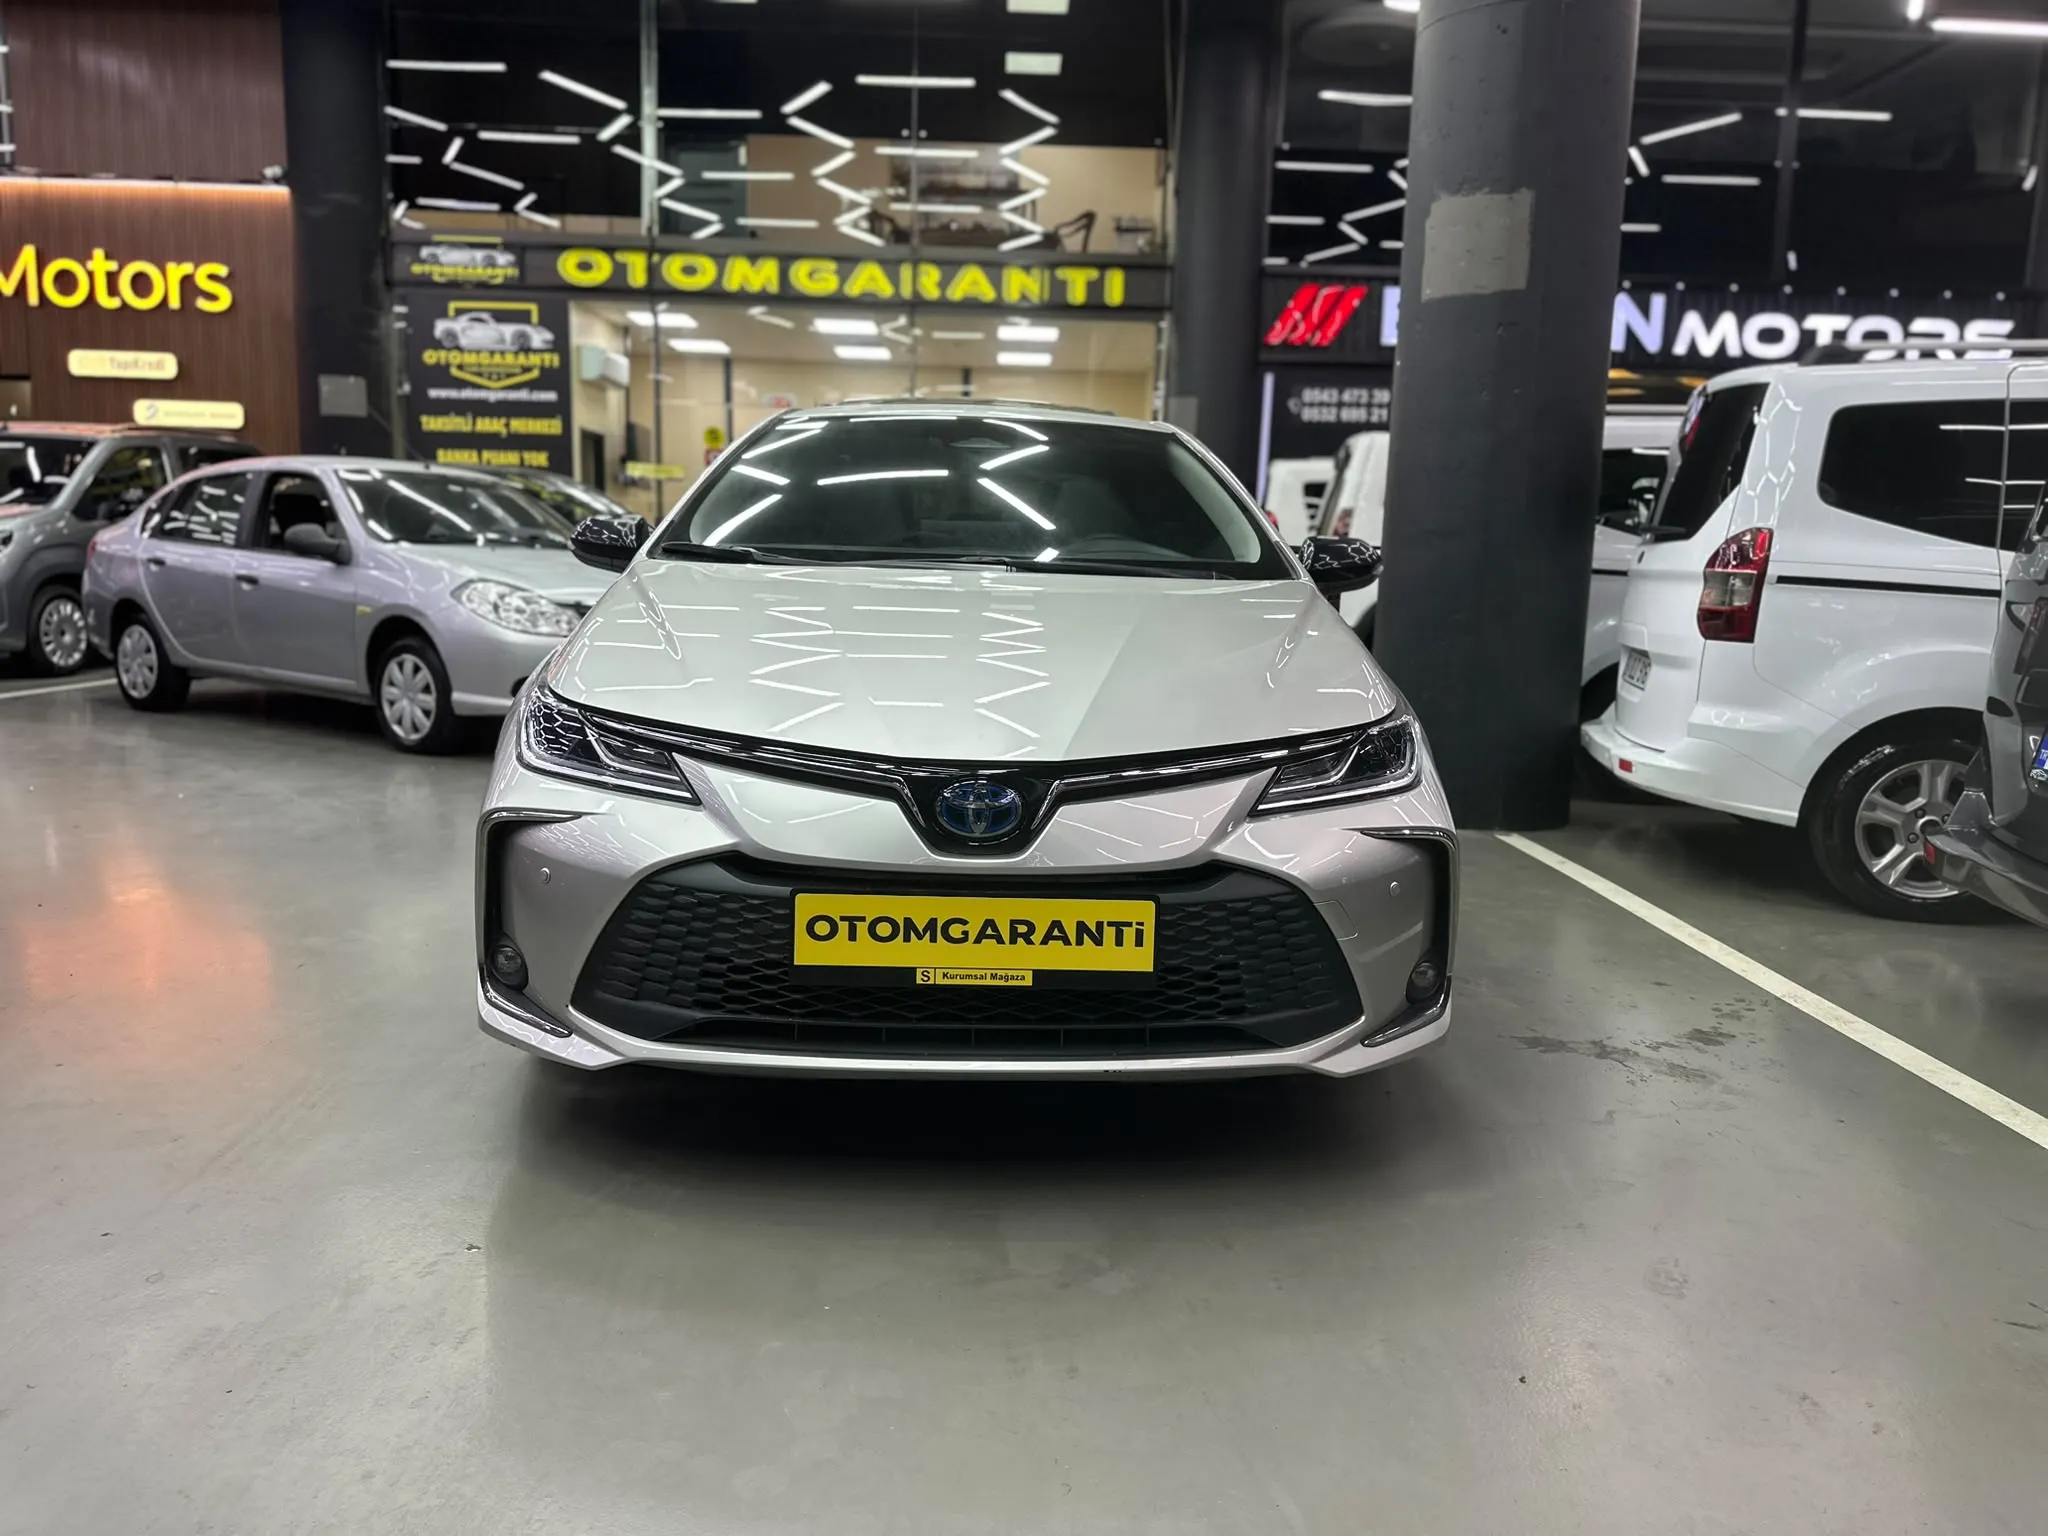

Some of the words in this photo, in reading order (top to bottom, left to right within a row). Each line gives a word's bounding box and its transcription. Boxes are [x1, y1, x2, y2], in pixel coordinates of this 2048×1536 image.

[0, 244, 233, 313] Motors
[556, 247, 1125, 306] OTOMGARANTI
[1671, 310, 2016, 360] MOTORS
[942, 971, 988, 982] Kurumsal
[990, 972, 1026, 985] Mağaza
